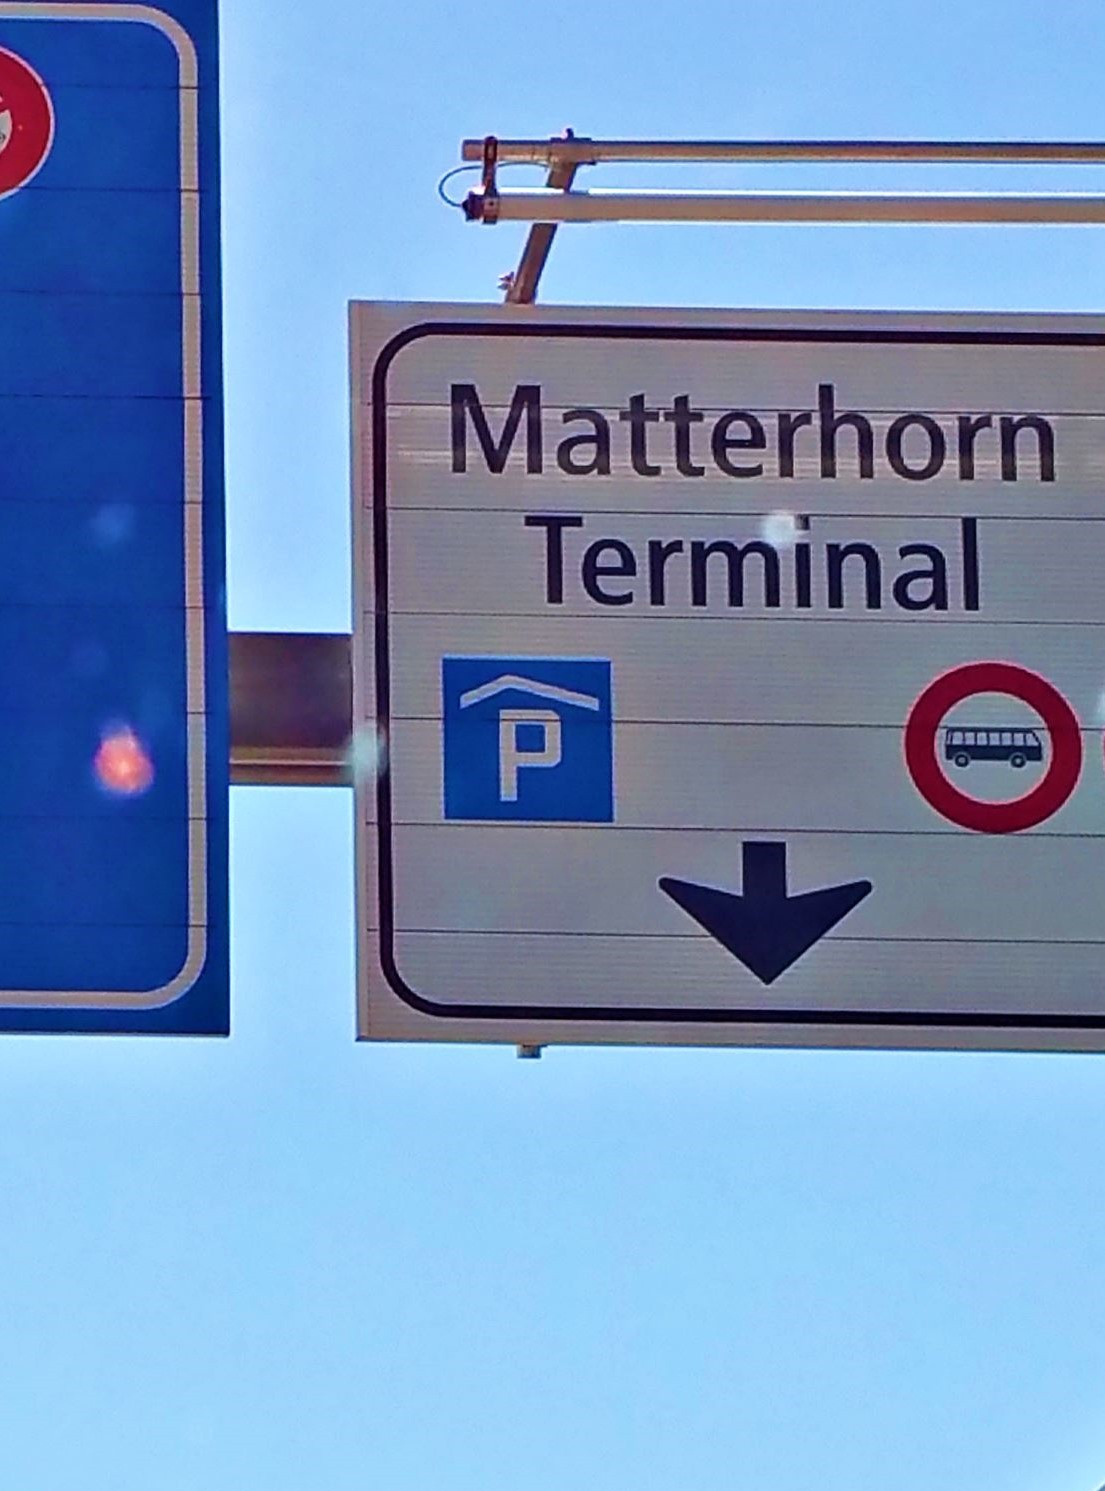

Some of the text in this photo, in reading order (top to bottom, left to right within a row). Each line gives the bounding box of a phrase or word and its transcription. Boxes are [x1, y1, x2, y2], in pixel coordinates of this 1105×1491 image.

[449, 383, 1057, 483] Matterhorn
[524, 514, 981, 613] Terminal
[499, 709, 562, 802] P
